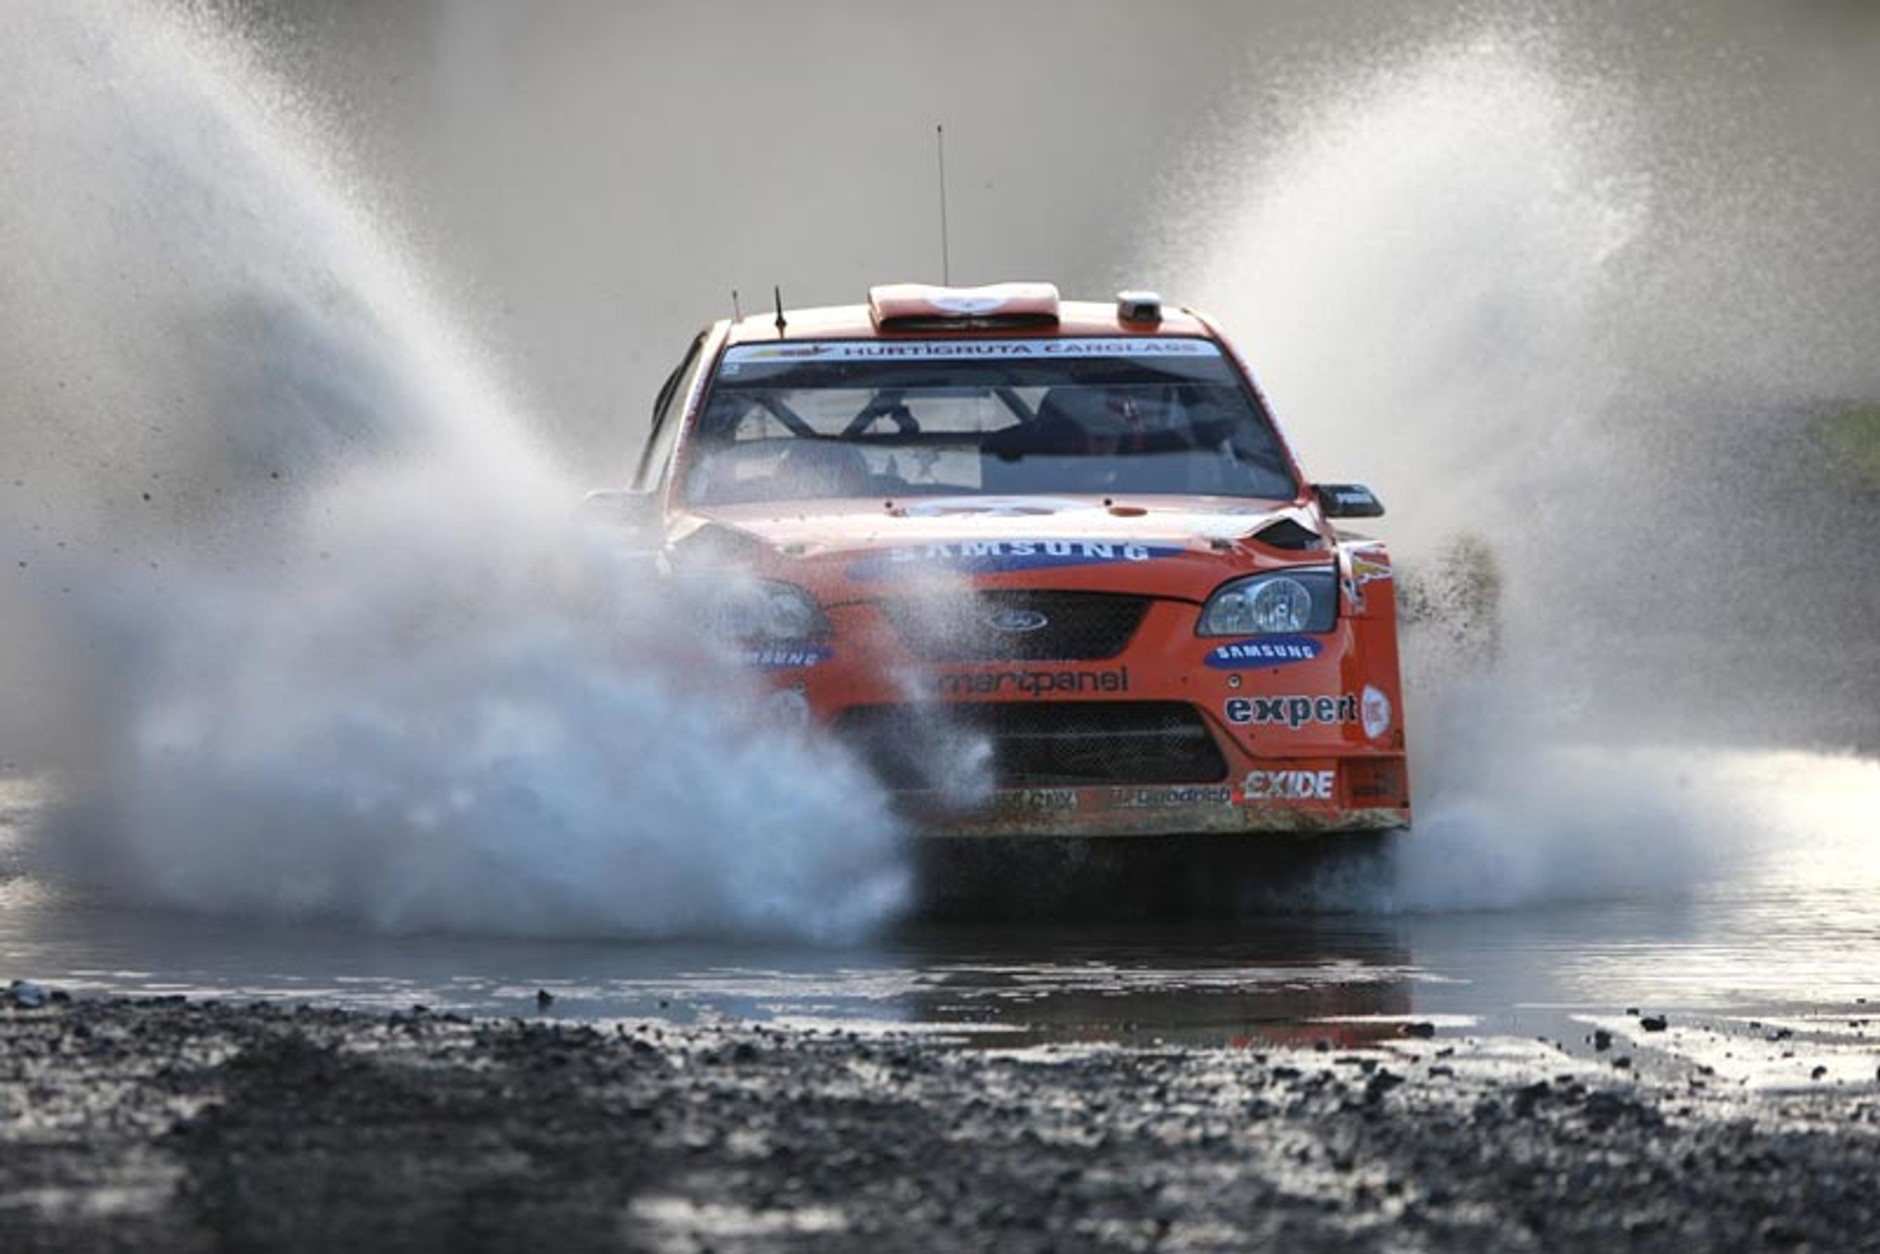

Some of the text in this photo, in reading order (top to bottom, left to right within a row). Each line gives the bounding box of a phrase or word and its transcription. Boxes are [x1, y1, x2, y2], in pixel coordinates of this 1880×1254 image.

[1044, 342, 1197, 354] CARGLASS
[1216, 644, 1315, 660] SAMSUNG
[928, 665, 1129, 696] martpanel
[1226, 693, 1359, 728] expert
[1244, 769, 1335, 799] EXIDE
